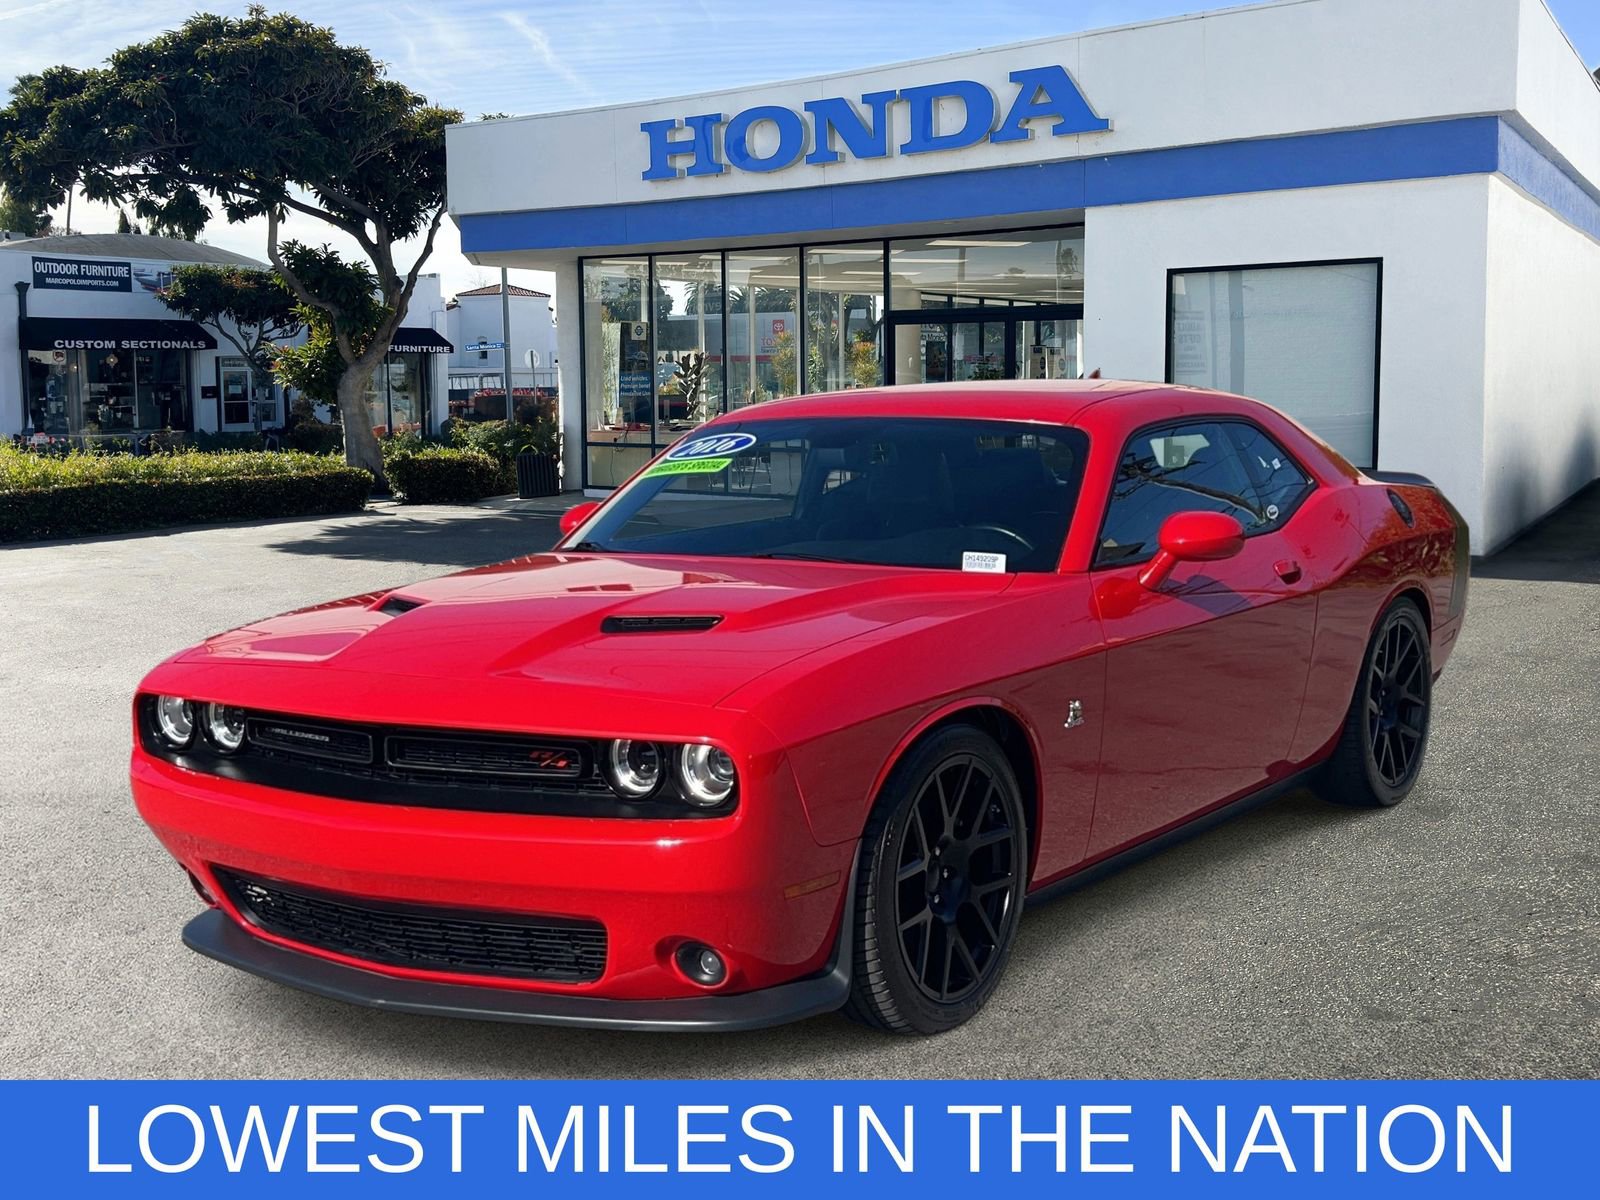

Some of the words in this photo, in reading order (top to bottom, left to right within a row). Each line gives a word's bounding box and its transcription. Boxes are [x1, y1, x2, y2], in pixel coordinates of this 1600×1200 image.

[640, 65, 1114, 181] HONDA
[34, 261, 79, 275] OUTDOOR
[80, 264, 130, 278] FURNITURE
[45, 277, 119, 287] MARCOPOLOIMPORTS.COM
[54, 340, 116, 349] CUSTOM
[121, 340, 206, 349] SECTIONALS
[388, 344, 451, 353] FURNITURE
[674, 437, 742, 457] 2016
